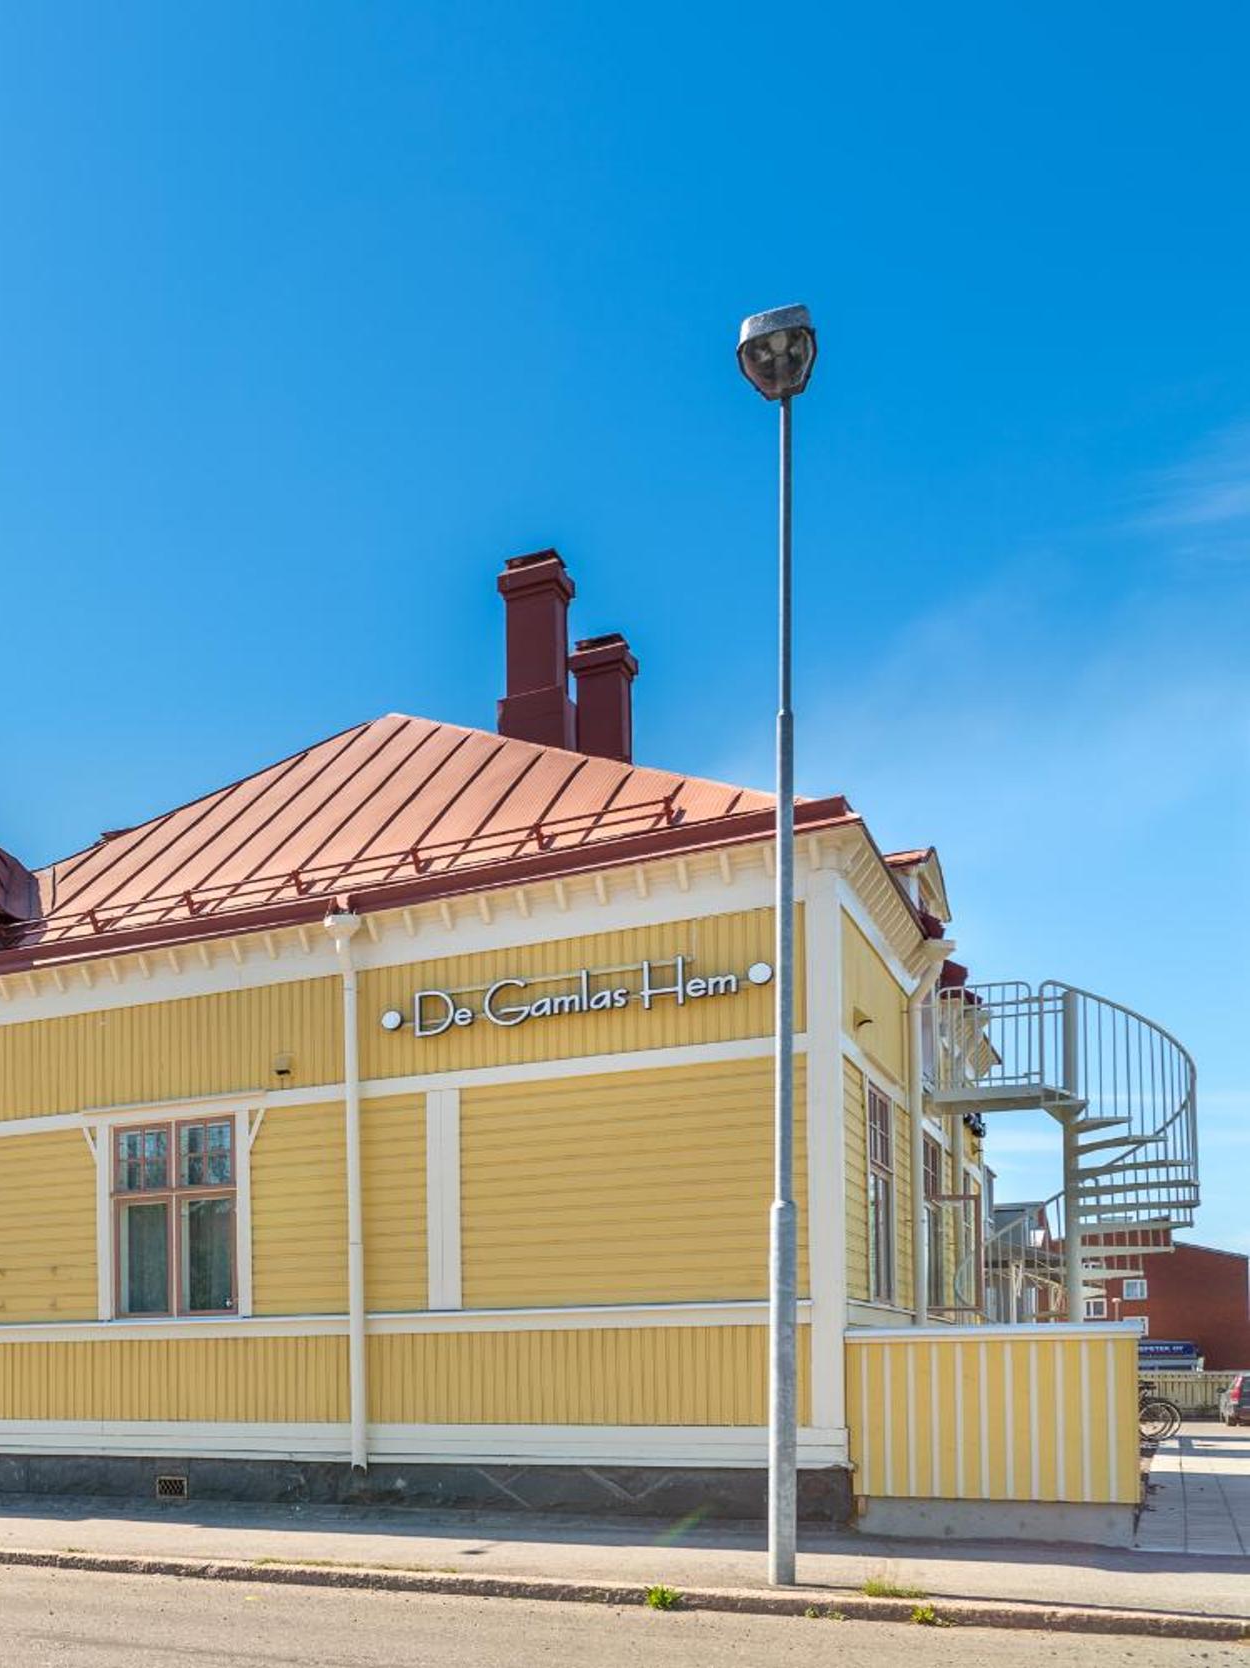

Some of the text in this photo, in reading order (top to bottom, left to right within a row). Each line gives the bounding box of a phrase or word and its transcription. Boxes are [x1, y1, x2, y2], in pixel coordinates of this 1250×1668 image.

[413, 954, 739, 1038] De Gamlas Hem
